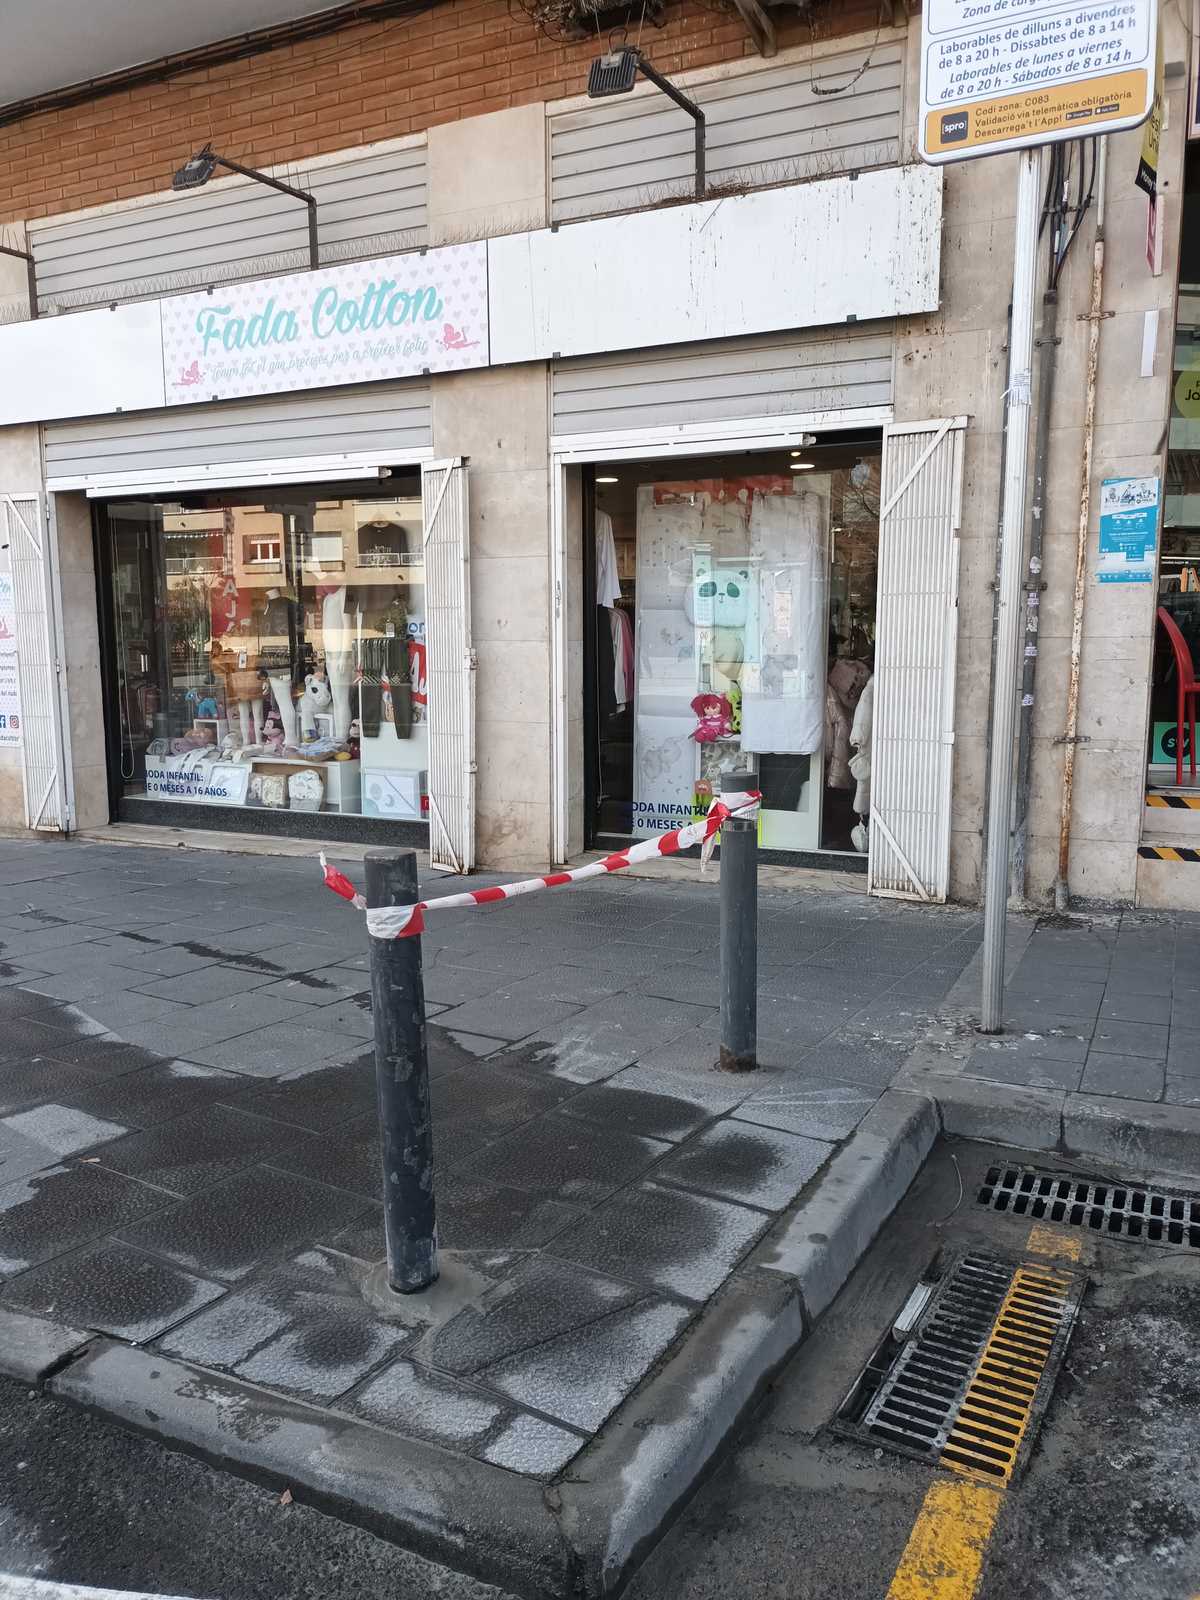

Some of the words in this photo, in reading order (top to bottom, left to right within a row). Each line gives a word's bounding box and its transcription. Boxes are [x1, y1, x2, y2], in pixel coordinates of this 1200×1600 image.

[962, 4, 991, 19] Zona
[993, 0, 1008, 11] de
[940, 33, 1001, 56] Laborables
[1004, 28, 1019, 40] de
[1022, 18, 1062, 35] dilluns
[1064, 18, 1072, 27] a
[1075, 4, 1136, 25] divendres
[939, 58, 953, 70] de
[955, 54, 963, 66] 8
[965, 54, 972, 64] a
[975, 48, 989, 61] 20
[992, 46, 999, 57] h
[1010, 32, 1066, 53] Dissabtes
[1069, 28, 1085, 40] de
[1088, 24, 1096, 36] 8
[1099, 24, 1106, 34] a
[1110, 18, 1125, 32] 14
[1128, 17, 1136, 28] h
[950, 61, 1012, 84] Laborables
[1015, 57, 1030, 69] de
[1032, 50, 1064, 65] lunes
[1067, 48, 1075, 58] a
[1078, 38, 1122, 56] viernes
[940, 87, 954, 99] de
[956, 84, 965, 96] 8
[966, 84, 974, 94] a
[977, 78, 992, 92] 20
[993, 76, 1002, 88] h
[1011, 65, 1062, 84] Sábados
[1065, 60, 1080, 73] de
[1082, 57, 1091, 69] 8
[1093, 57, 1102, 67] a
[1105, 51, 1120, 65] 14
[1123, 49, 1132, 60] h
[975, 105, 996, 117] Codi
[998, 102, 1023, 112] zona:
[1024, 94, 1050, 107] C083
[975, 113, 1015, 128] Validació
[1017, 110, 1030, 120] via
[196, 298, 299, 356] Fada
[312, 280, 443, 340] Cotton
[144, 769, 165, 780] ODA
[166, 771, 204, 782] INFANTIL:
[160, 784, 185, 794] MESES
[186, 785, 192, 794] A
[194, 786, 203, 795] 16
[632, 802, 655, 813] ODA
